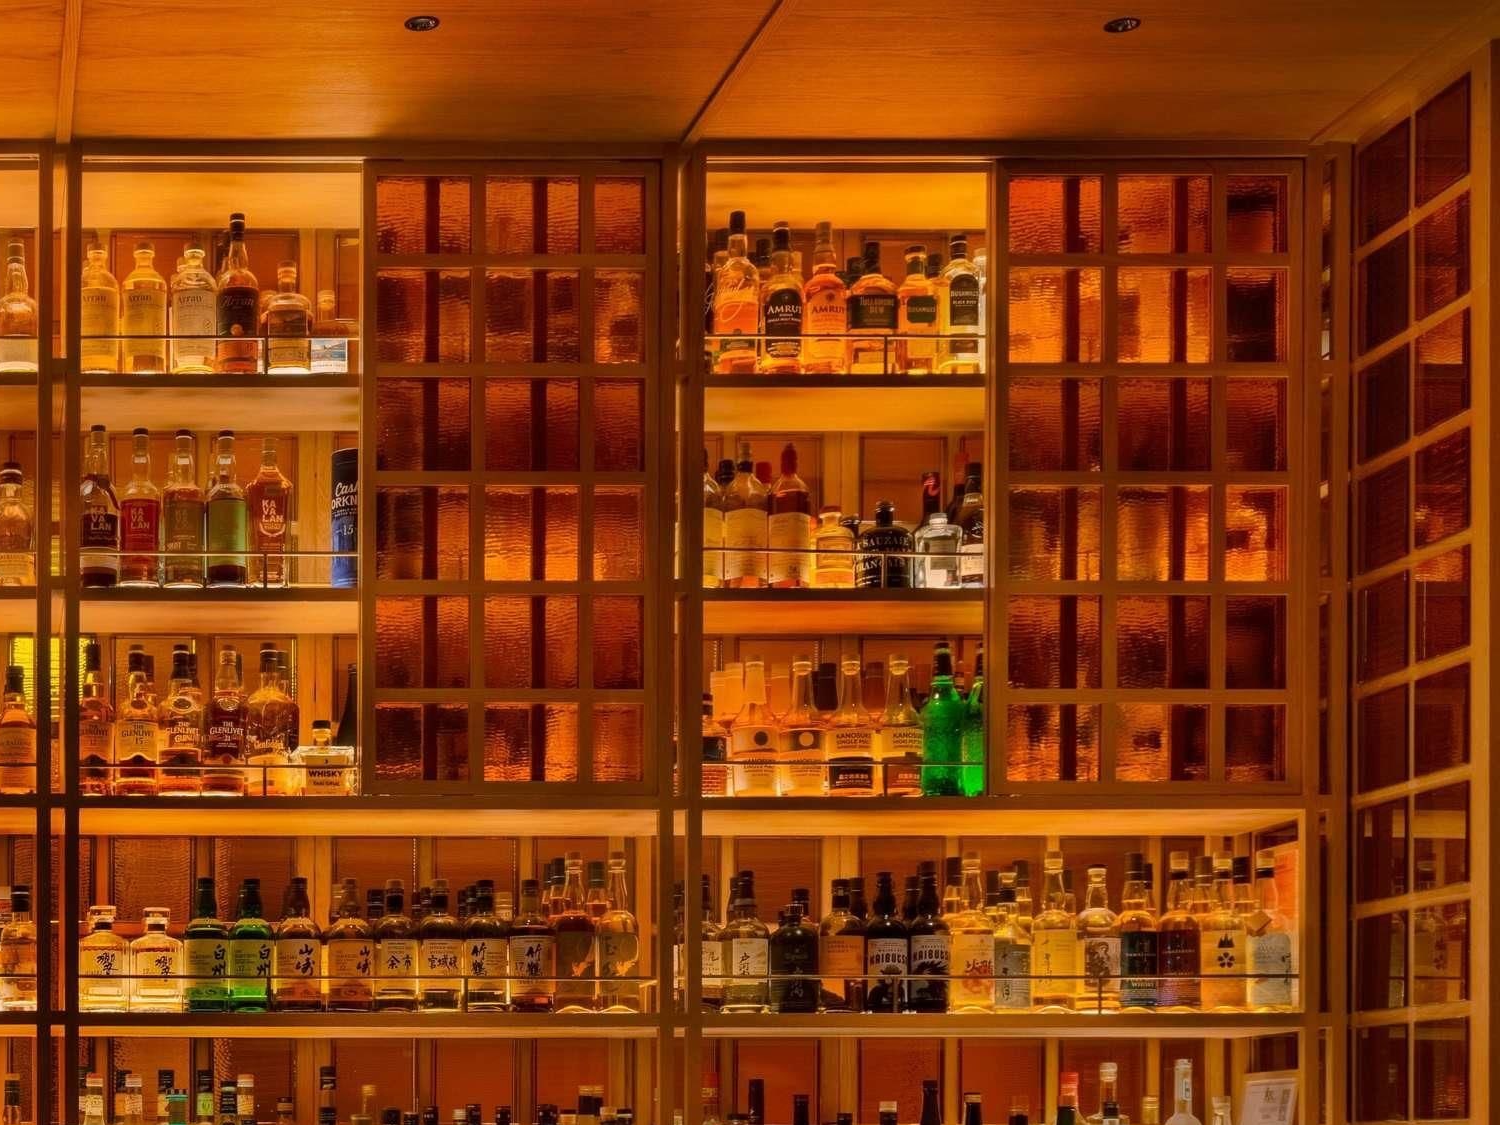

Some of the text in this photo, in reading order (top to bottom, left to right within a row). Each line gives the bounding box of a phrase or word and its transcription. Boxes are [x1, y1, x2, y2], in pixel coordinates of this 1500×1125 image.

[767, 304, 802, 314] AMRUT
[811, 304, 845, 314] AMRUT
[262, 514, 284, 523] LAN
[80, 728, 108, 737] LENLIVET
[210, 727, 244, 736] GLENLIVET
[308, 769, 343, 778] WHISKY
[211, 944, 226, 977] 白州
[256, 944, 270, 977] 白州
[296, 944, 315, 977] 山崎
[386, 954, 412, 970] 余市
